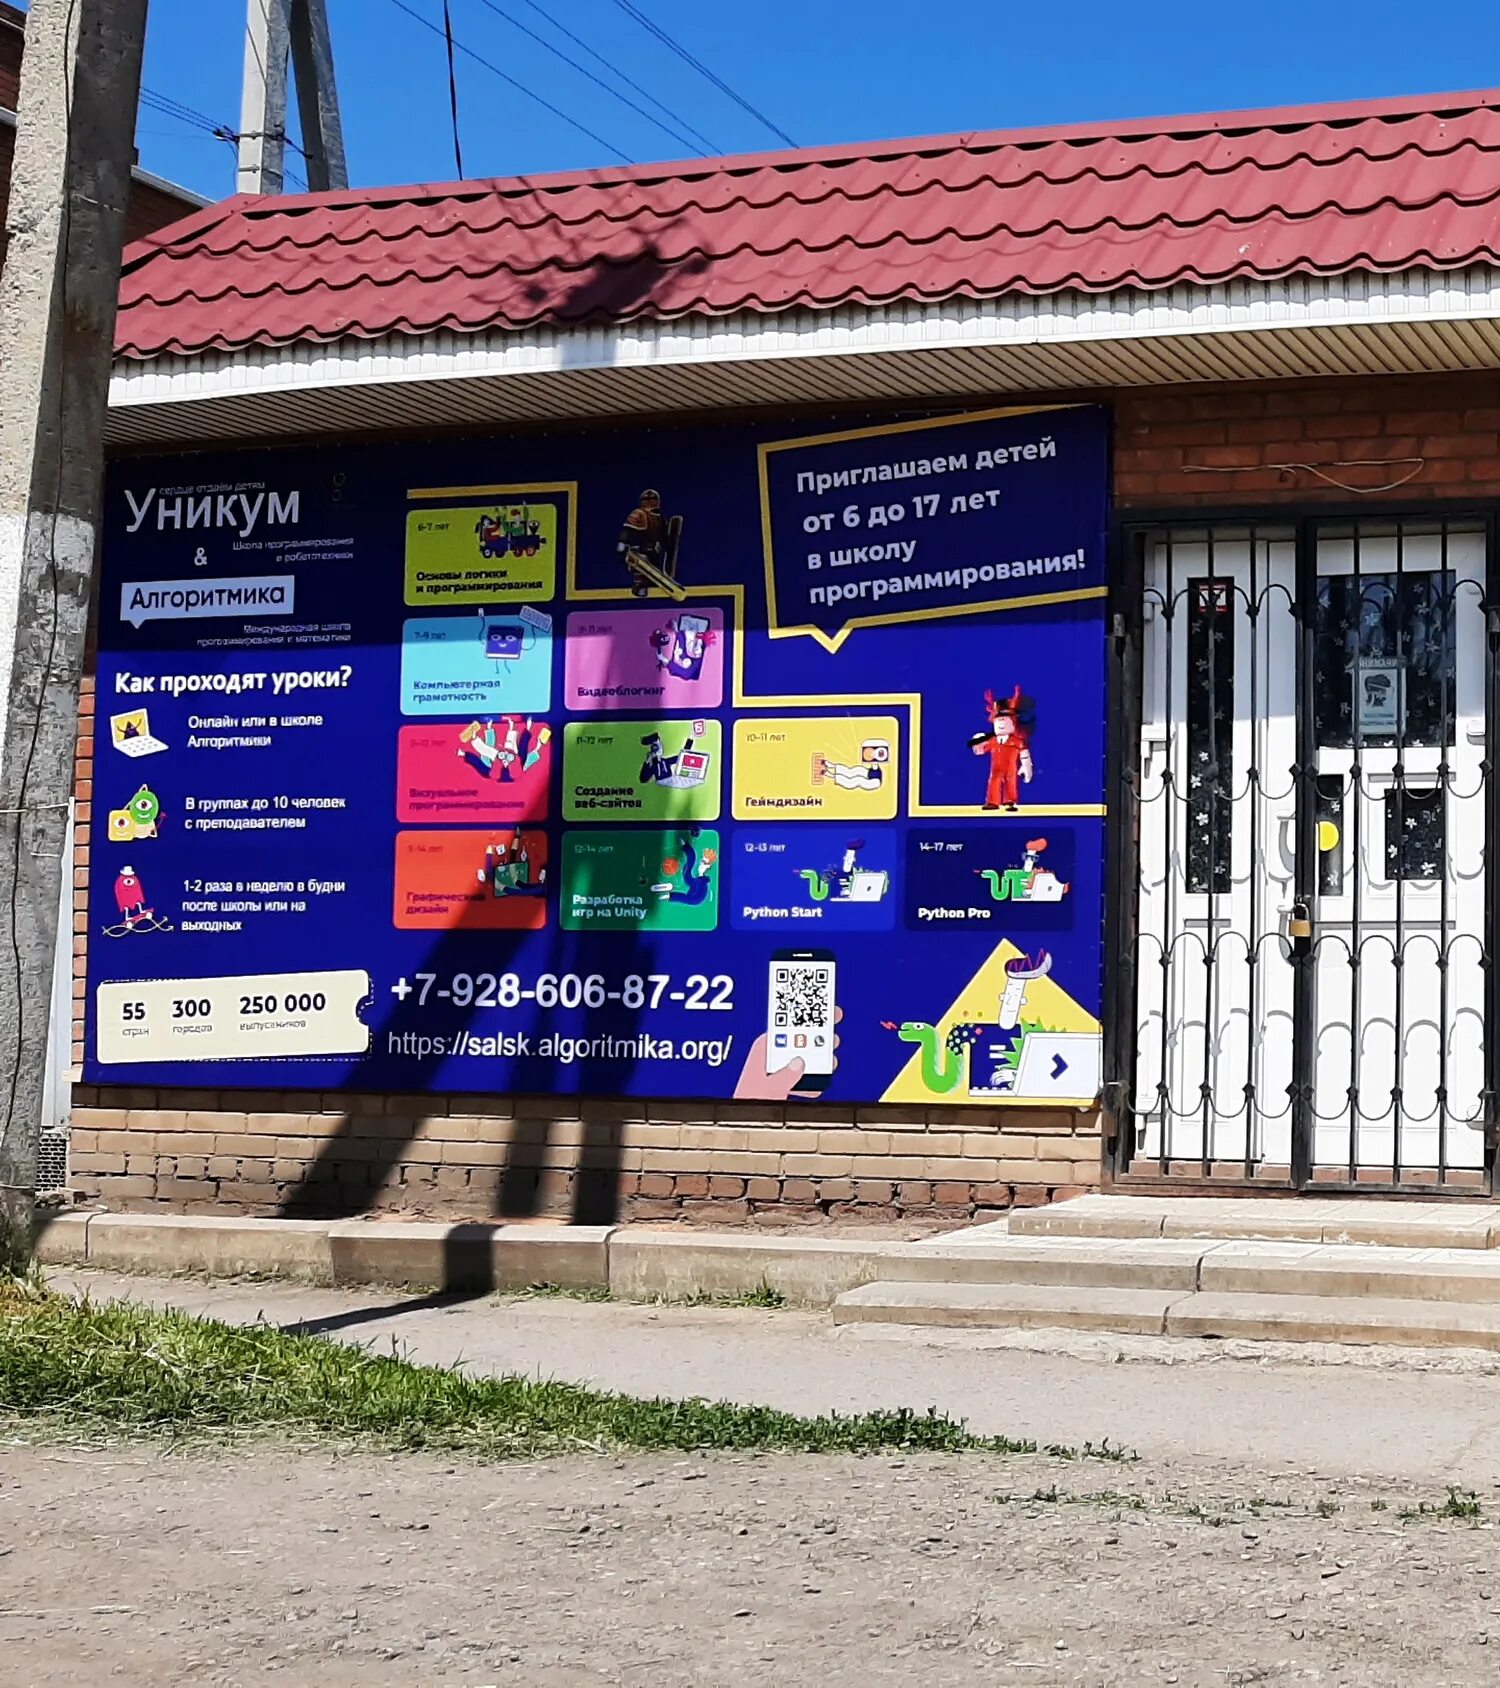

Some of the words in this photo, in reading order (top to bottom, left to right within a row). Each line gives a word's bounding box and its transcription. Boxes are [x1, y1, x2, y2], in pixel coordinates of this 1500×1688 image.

[797, 453, 968, 495] Приглашаем
[975, 436, 1057, 470] детей
[124, 487, 300, 538] Уникум
[803, 512, 835, 533] от
[842, 505, 860, 529] 6
[867, 503, 905, 529] до
[912, 494, 941, 518] 17
[949, 488, 1001, 514] лет
[194, 548, 208, 566] &
[807, 553, 822, 570] в
[829, 540, 917, 568] школу
[416, 571, 463, 583] Основы
[465, 569, 508, 581] логики
[809, 549, 1086, 607] программирования!
[416, 584, 424, 594] и
[426, 580, 543, 596] программирования
[129, 585, 285, 612] Алгоритмика
[115, 672, 154, 693] Как
[160, 672, 267, 697] проходят
[272, 665, 352, 694] уроки?
[413, 680, 501, 692] Компьютерная
[412, 691, 487, 704] грамотность
[577, 685, 665, 698] Видеоблогинг
[188, 715, 238, 729] Онлайн
[242, 716, 266, 728] или
[269, 717, 278, 727] в
[281, 715, 323, 727] школе
[187, 735, 272, 750] Алгоритмики
[409, 787, 479, 798] Визуальное
[575, 785, 634, 798] Создание
[185, 797, 195, 809] В
[198, 798, 248, 813] группах
[251, 798, 269, 812] до
[273, 796, 289, 809] 10
[291, 796, 346, 809] человек
[409, 799, 525, 811] программирование
[574, 797, 642, 810] веб-сайтов
[745, 795, 823, 808] Геймдизайн
[185, 819, 193, 829] с
[195, 817, 306, 832] преподавателем
[183, 880, 202, 892] 1-2
[204, 882, 233, 895] раза
[235, 882, 243, 892] в
[246, 882, 294, 895] неделю
[297, 882, 305, 892] в
[307, 879, 345, 894] будни
[182, 902, 217, 912] после
[221, 901, 262, 913] школы
[265, 901, 288, 911] или
[291, 901, 306, 911] на
[572, 894, 643, 906] Разработка
[405, 903, 449, 915] дизайн
[572, 906, 594, 919] игр
[597, 906, 612, 917] на
[614, 905, 647, 919] Unity
[743, 906, 788, 920] Python
[791, 906, 823, 918] Start
[918, 907, 965, 920] Python
[968, 908, 990, 919] Pro
[181, 920, 242, 932] выходных
[390, 973, 734, 1010] +7-928-606-87-22
[122, 1002, 146, 1020] 55
[172, 999, 211, 1018] 300
[239, 996, 278, 1015] 250
[285, 992, 326, 1012] 000
[388, 1031, 733, 1067] https://salsk.algoritmika.org/
